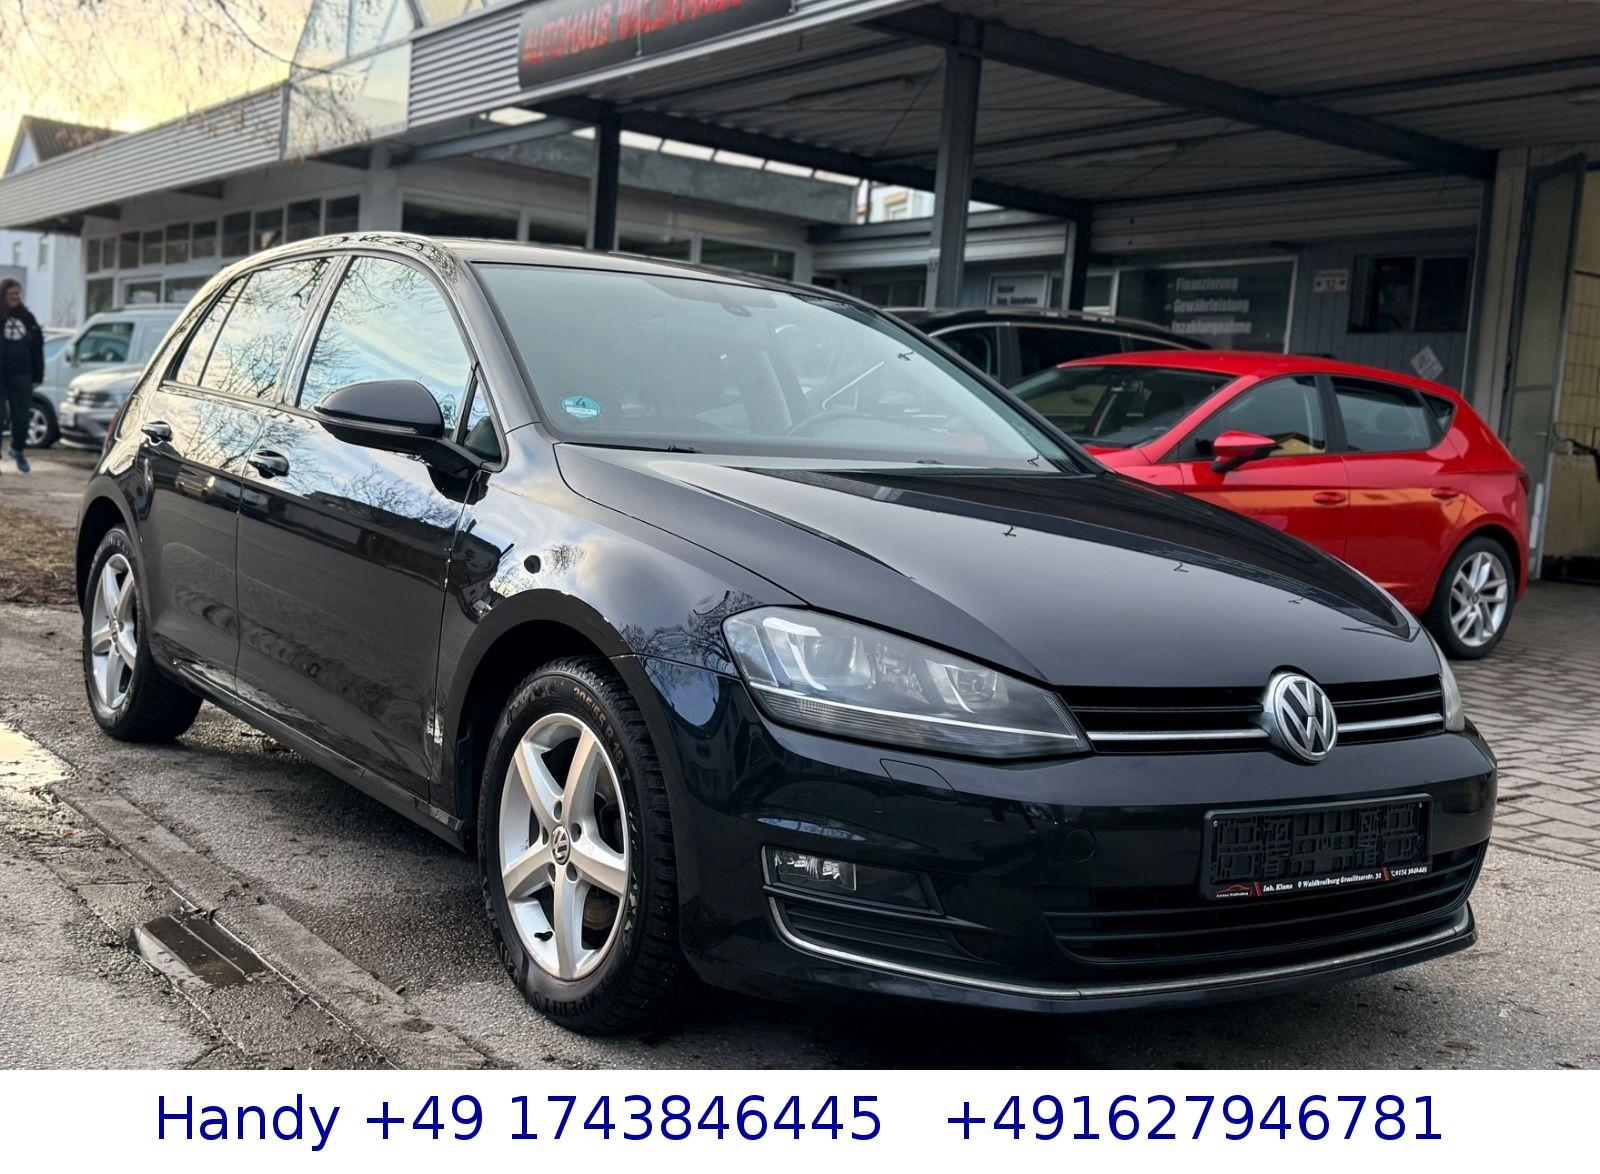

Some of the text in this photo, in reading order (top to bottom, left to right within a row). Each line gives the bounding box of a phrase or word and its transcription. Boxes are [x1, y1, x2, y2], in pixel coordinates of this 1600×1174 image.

[522, 2, 613, 64] AUTOHAUS
[1175, 277, 1239, 292] Finanzierung
[1172, 297, 1250, 314] Gewährleistung
